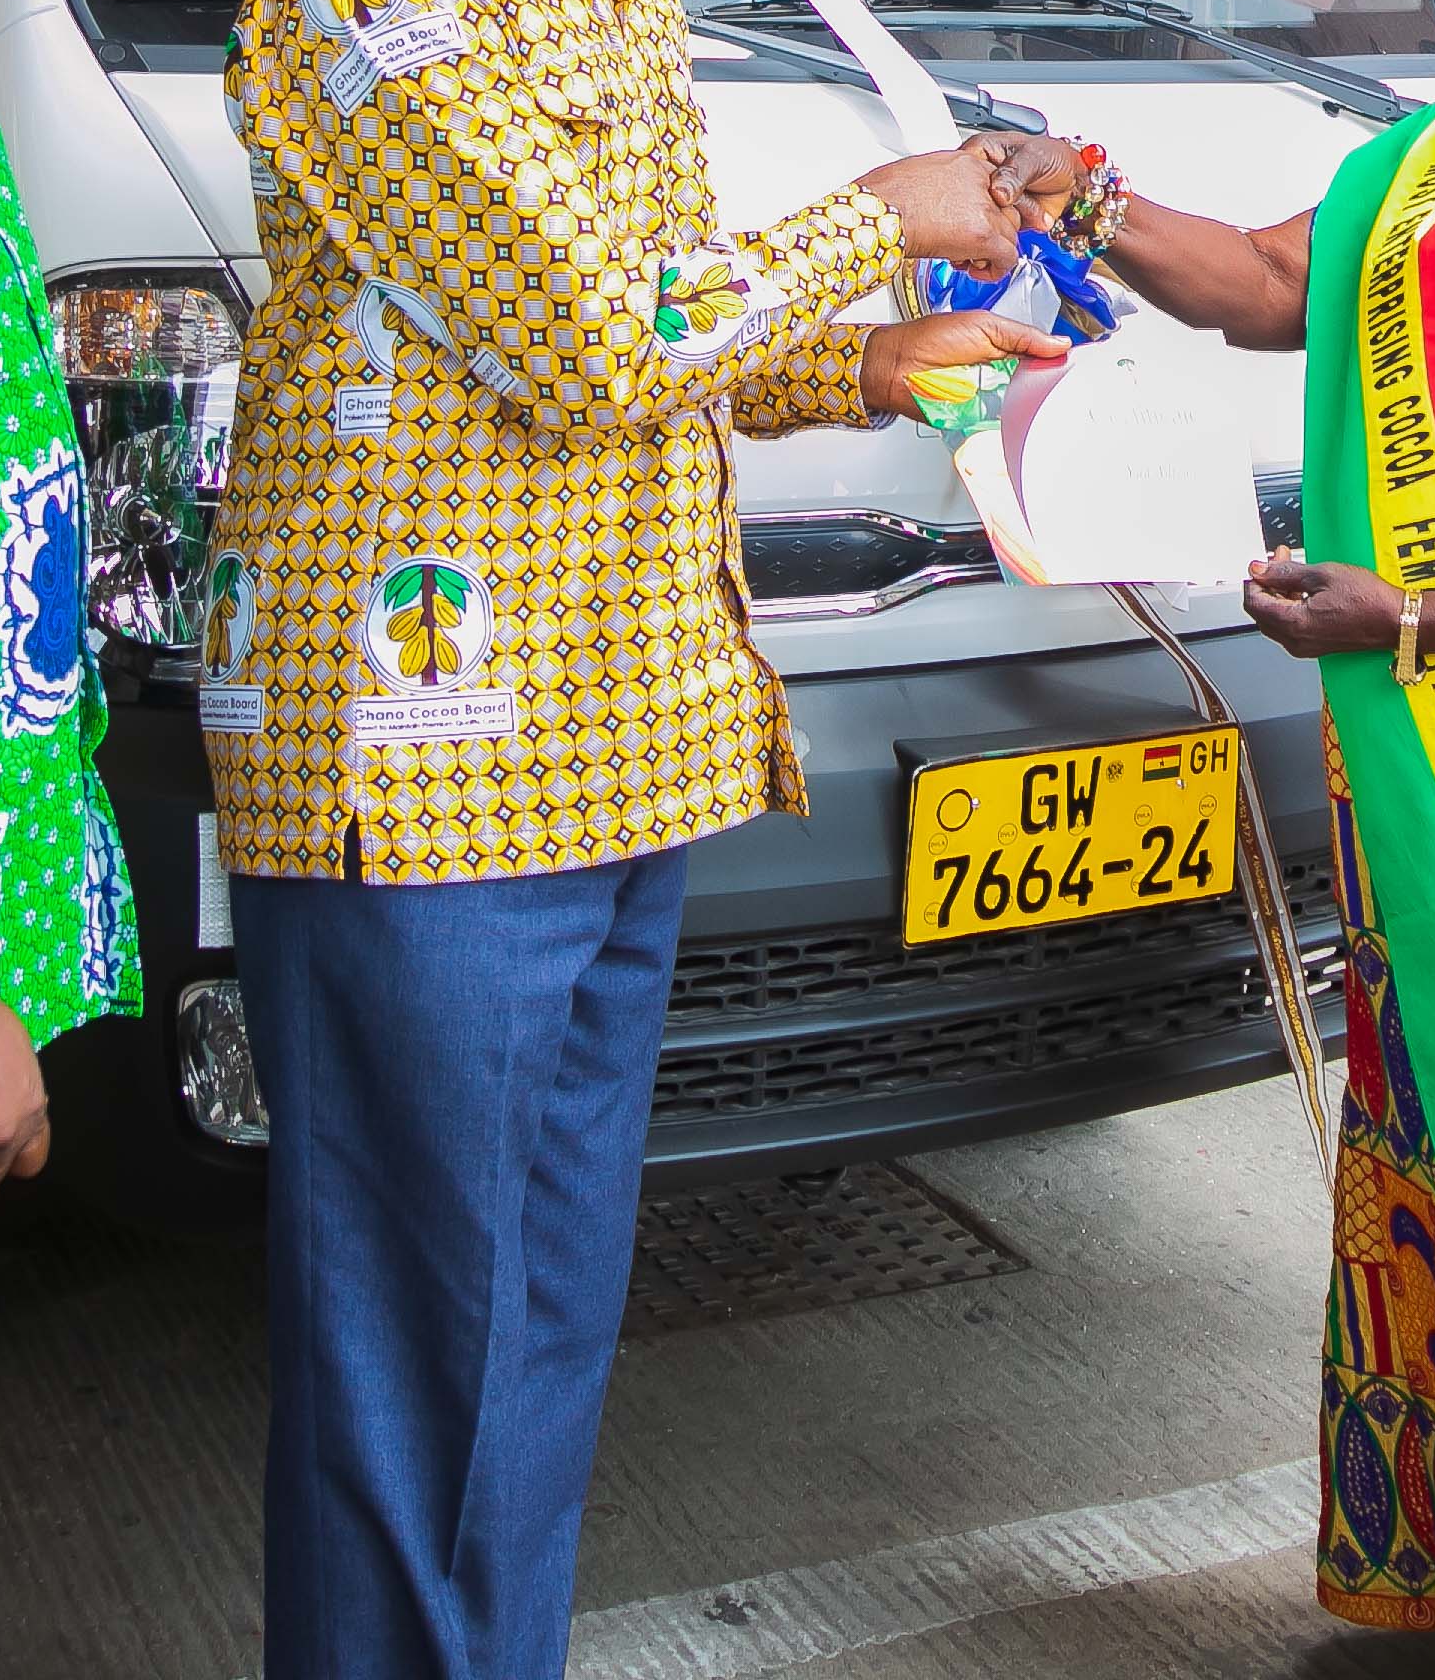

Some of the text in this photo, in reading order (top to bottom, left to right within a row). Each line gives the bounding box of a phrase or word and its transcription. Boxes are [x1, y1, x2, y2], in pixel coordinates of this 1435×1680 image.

[334, 53, 366, 91] Ghana
[1367, 208, 1434, 390] ENTERPRISING
[230, 696, 258, 709] Board
[409, 706, 459, 719] Cocoa
[464, 702, 506, 715] Board
[1189, 737, 1230, 776] GH
[1020, 755, 1102, 835] GW
[933, 818, 1211, 929] 7664-24
